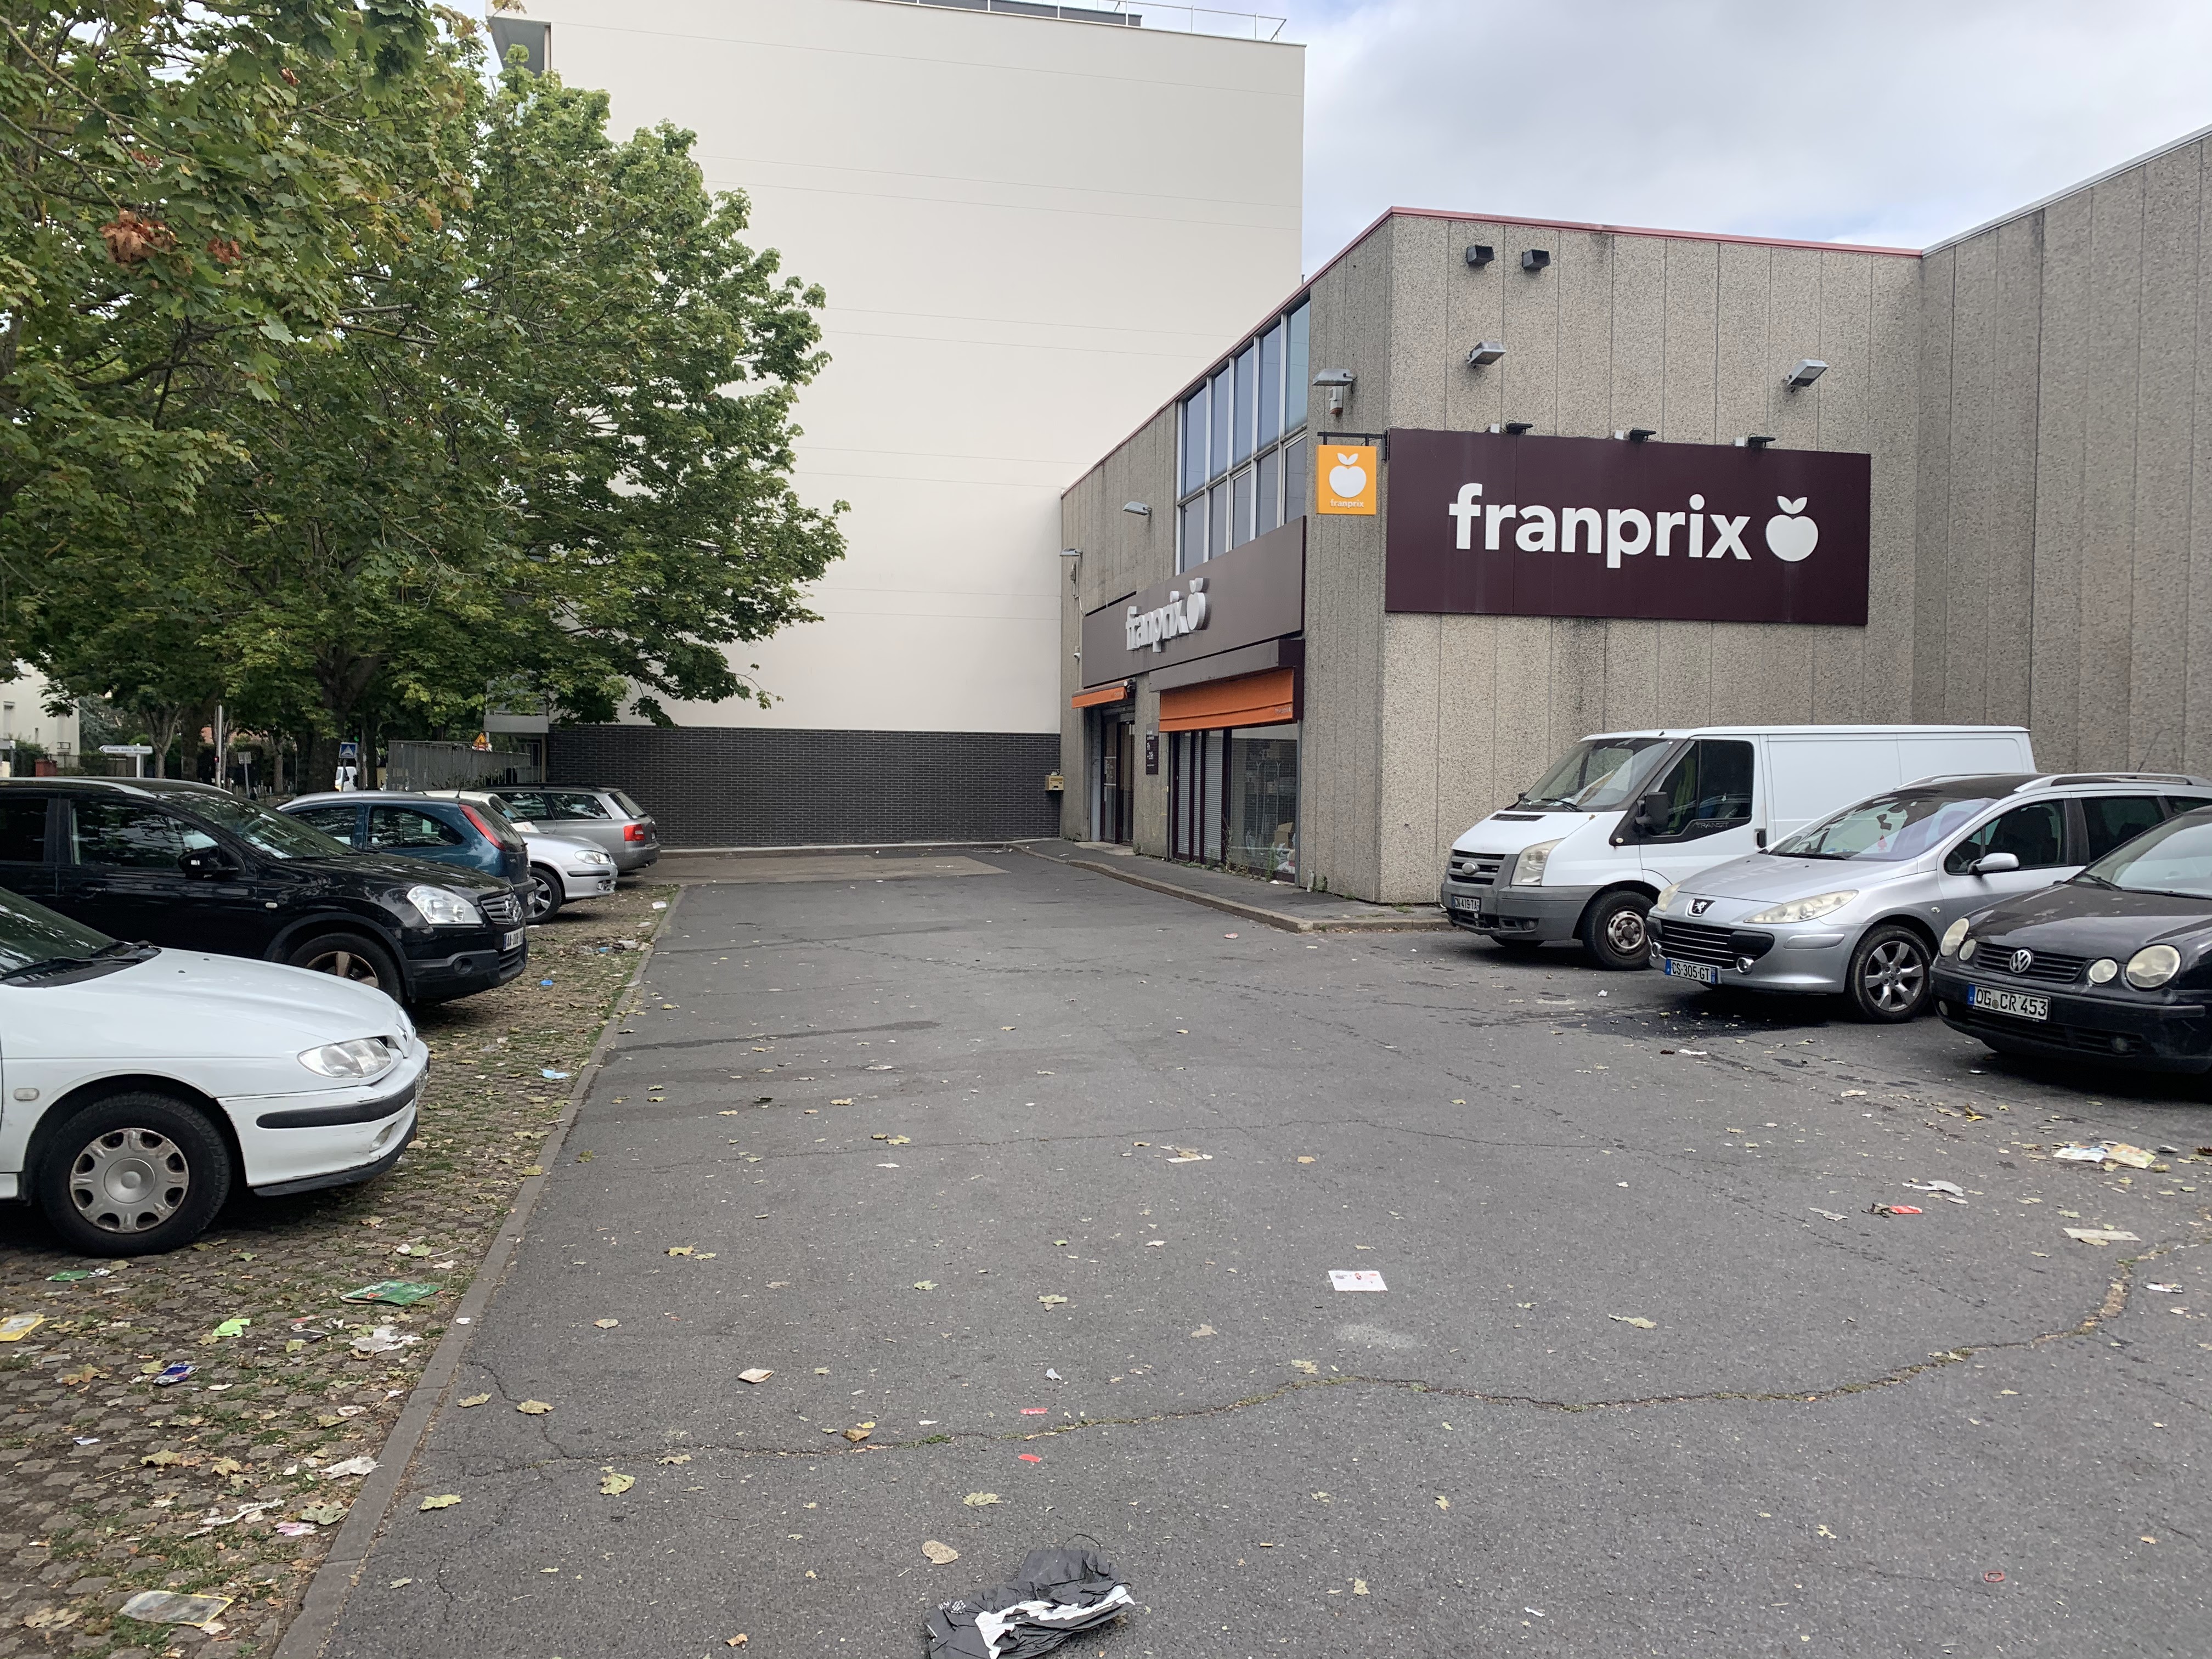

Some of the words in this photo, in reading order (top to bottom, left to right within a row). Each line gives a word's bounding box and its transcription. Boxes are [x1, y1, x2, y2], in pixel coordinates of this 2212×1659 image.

[1330, 499, 1364, 509] franprix
[1448, 483, 1752, 568] franprix
[1125, 590, 1189, 652] franprix
